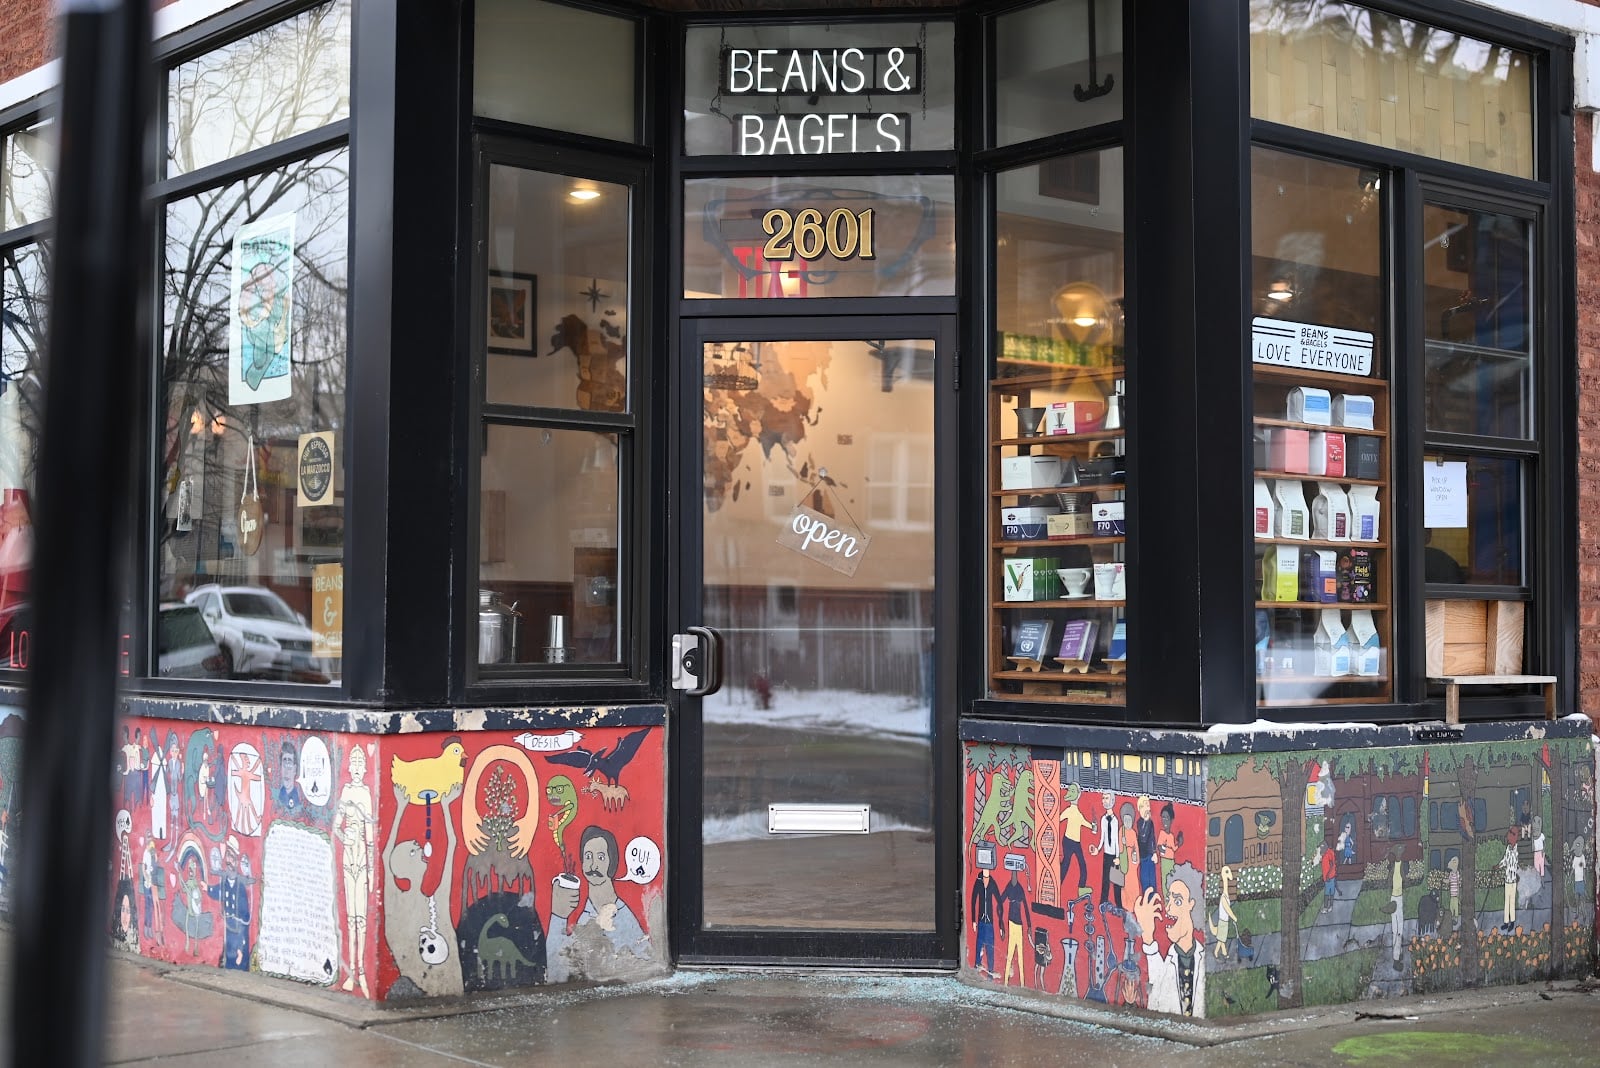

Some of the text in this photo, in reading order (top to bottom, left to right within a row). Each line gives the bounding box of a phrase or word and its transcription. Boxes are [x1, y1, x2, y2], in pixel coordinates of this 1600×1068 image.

[729, 47, 911, 93] BEANS &
[762, 208, 876, 261] 2601
[1300, 327, 1329, 340] BEANS
[1257, 342, 1365, 371] LOVE EVERYONE
[306, 463, 330, 475] MARZOCCO
[791, 513, 859, 558] open
[1006, 525, 1018, 535] F70
[1097, 521, 1110, 531] F70
[315, 574, 343, 592] BEANS
[323, 596, 337, 627] &
